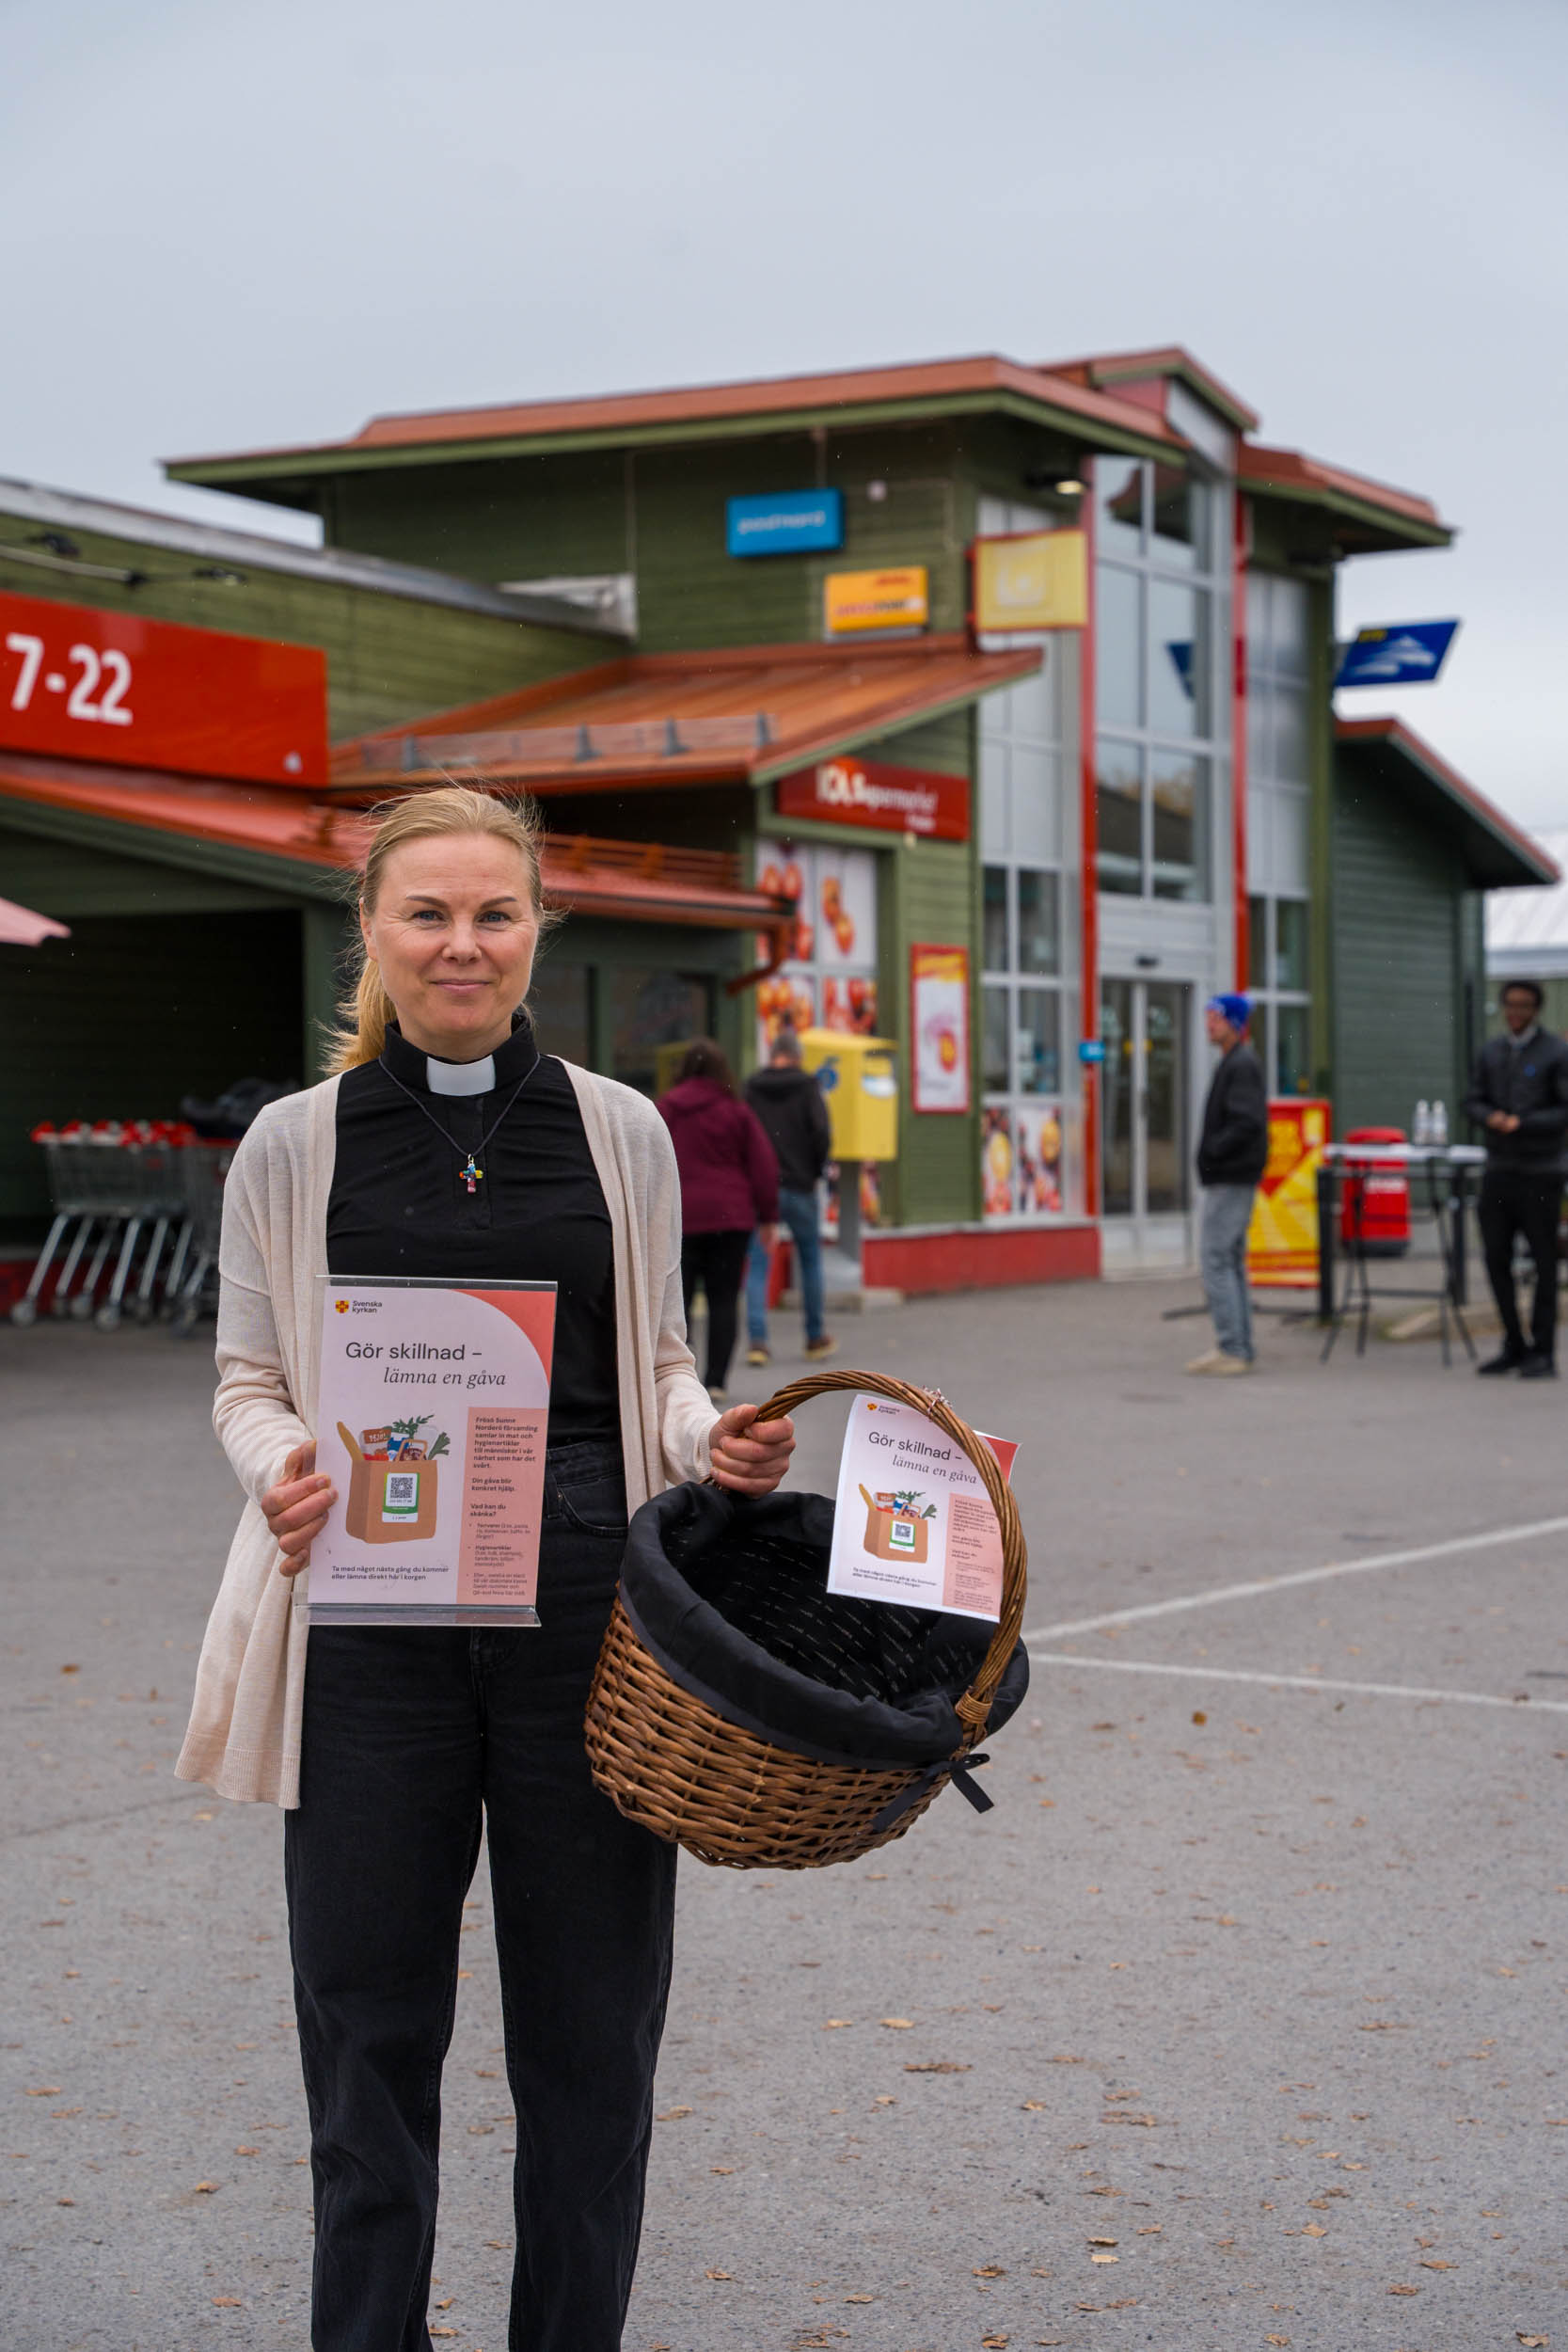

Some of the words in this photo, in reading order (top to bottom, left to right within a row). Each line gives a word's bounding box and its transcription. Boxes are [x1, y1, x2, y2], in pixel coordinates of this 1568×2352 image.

[346, 1343, 383, 1359] Gör
[389, 1343, 465, 1360] skillnad
[384, 1367, 436, 1385] lämna
[443, 1373, 462, 1385] en
[467, 1370, 506, 1390] gåva
[869, 1431, 895, 1447] Gör
[897, 1438, 951, 1461] skillnad
[892, 1454, 929, 1474] lämna
[933, 1468, 946, 1477] en
[949, 1469, 976, 1485] gåva
